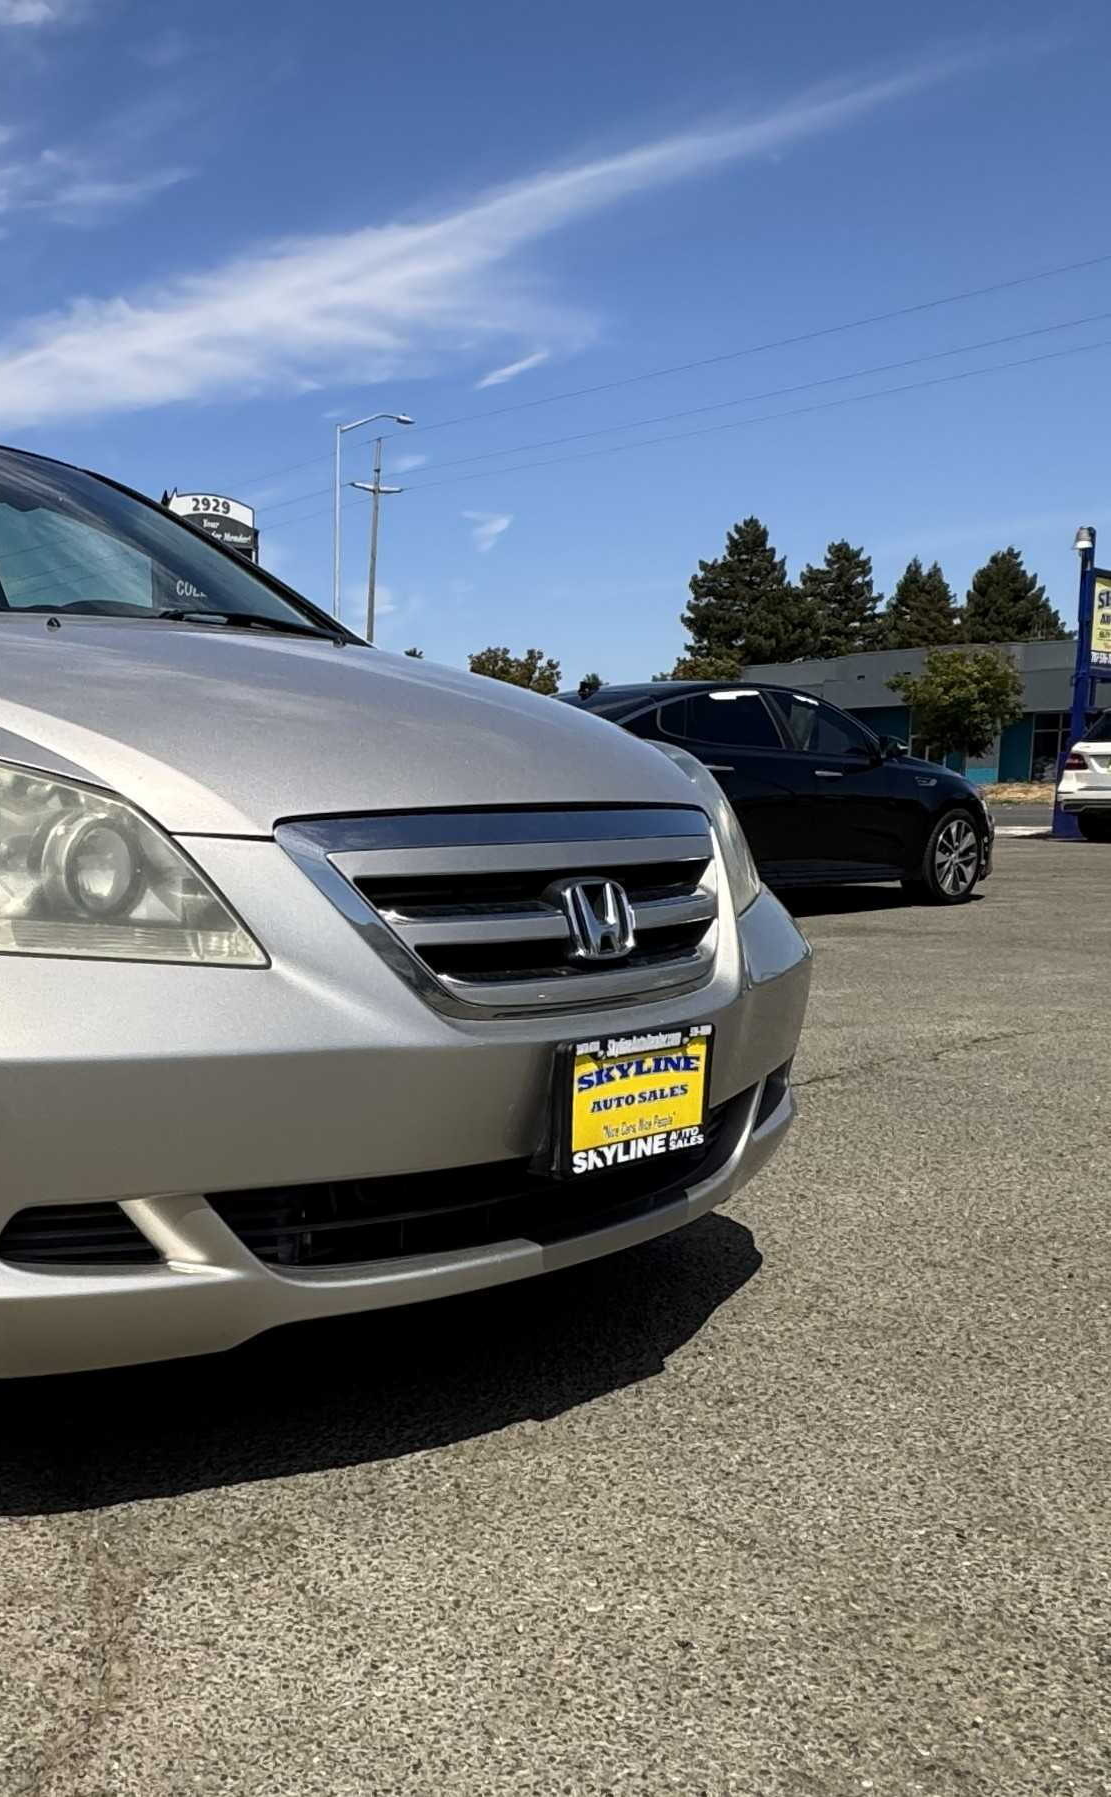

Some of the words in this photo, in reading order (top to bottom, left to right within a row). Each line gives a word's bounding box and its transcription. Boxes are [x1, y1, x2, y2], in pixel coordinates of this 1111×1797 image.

[192, 498, 231, 515] 2929
[577, 1055, 701, 1093] SKYLINE
[591, 1094, 635, 1113] AUTO
[637, 1084, 689, 1103] SALES
[669, 1126, 700, 1141] AUTO
[669, 1134, 705, 1151] SALES
[572, 1133, 667, 1174] SKYLINE
